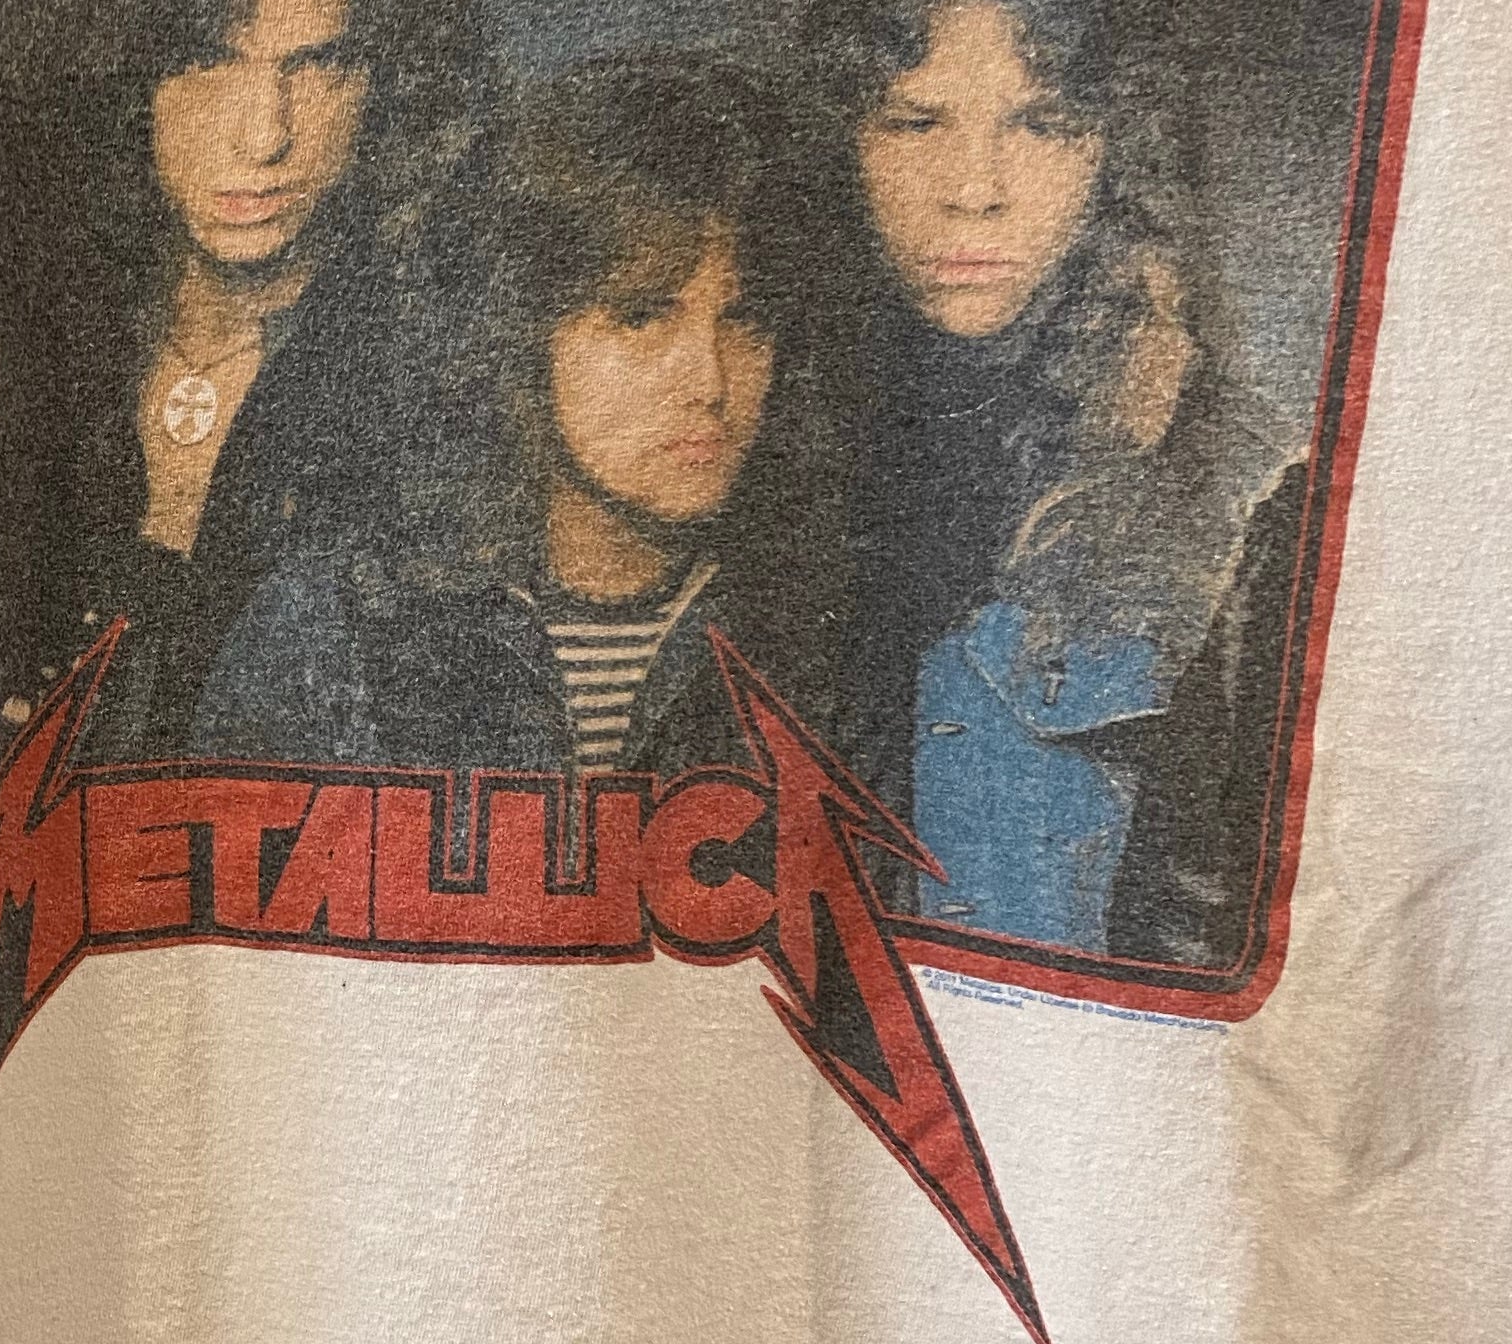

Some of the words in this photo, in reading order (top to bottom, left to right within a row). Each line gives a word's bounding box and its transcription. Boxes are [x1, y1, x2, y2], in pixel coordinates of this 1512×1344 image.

[928, 979, 940, 991] All
[943, 983, 973, 998] Rights
[1008, 986, 1037, 1000] Under
